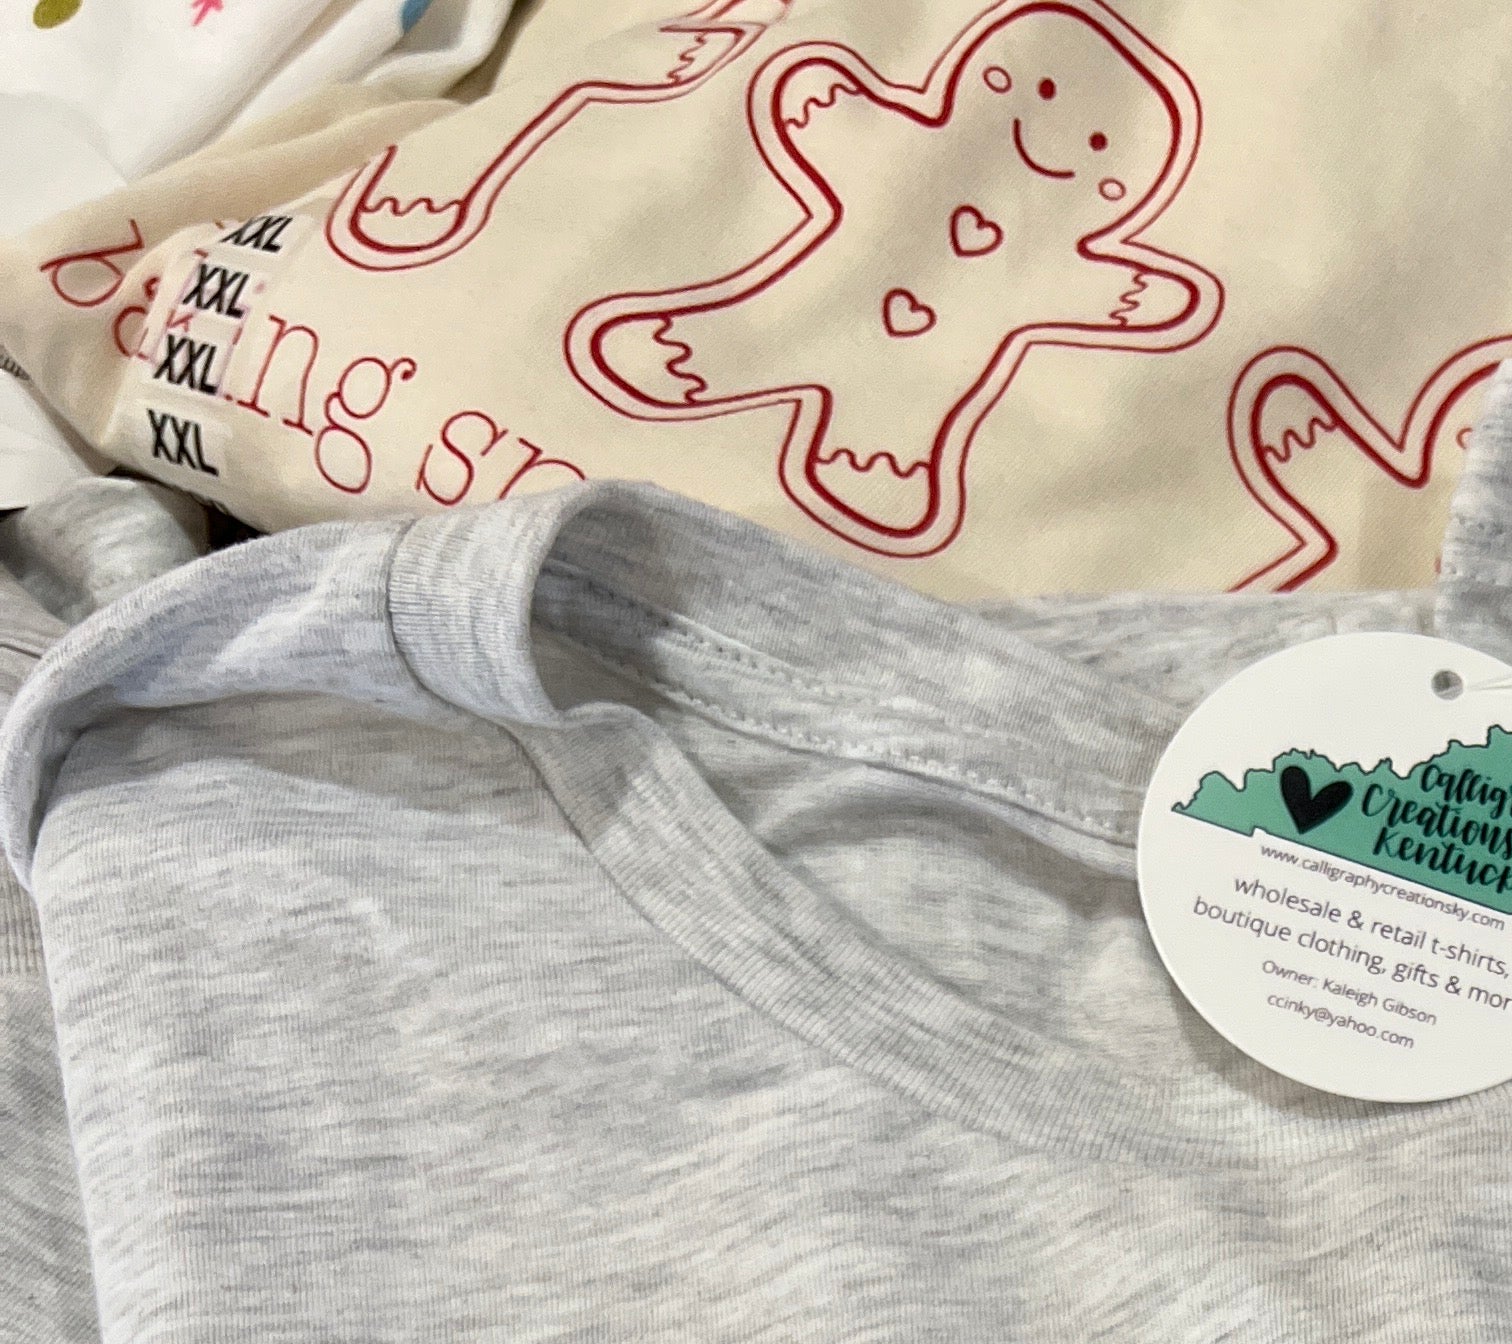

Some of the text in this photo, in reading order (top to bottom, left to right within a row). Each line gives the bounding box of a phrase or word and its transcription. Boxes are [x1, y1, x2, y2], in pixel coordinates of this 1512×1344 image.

[219, 215, 293, 253] XXL
[182, 262, 251, 319] XXL
[153, 334, 220, 396] XXL
[147, 408, 219, 477] XXL
[1261, 845, 1506, 931] www.calligraphycreationsky.com
[1193, 896, 1292, 942] boutique
[1298, 930, 1387, 975] clothing,
[1391, 962, 1440, 988] gifts
[1444, 975, 1462, 996] &
[1235, 878, 1510, 980] wholesale & retail t-shirts,
[1262, 960, 1438, 1026] Owner: Kaleigh Gibson
[1267, 994, 1415, 1049] ccinky@yahoo.com
